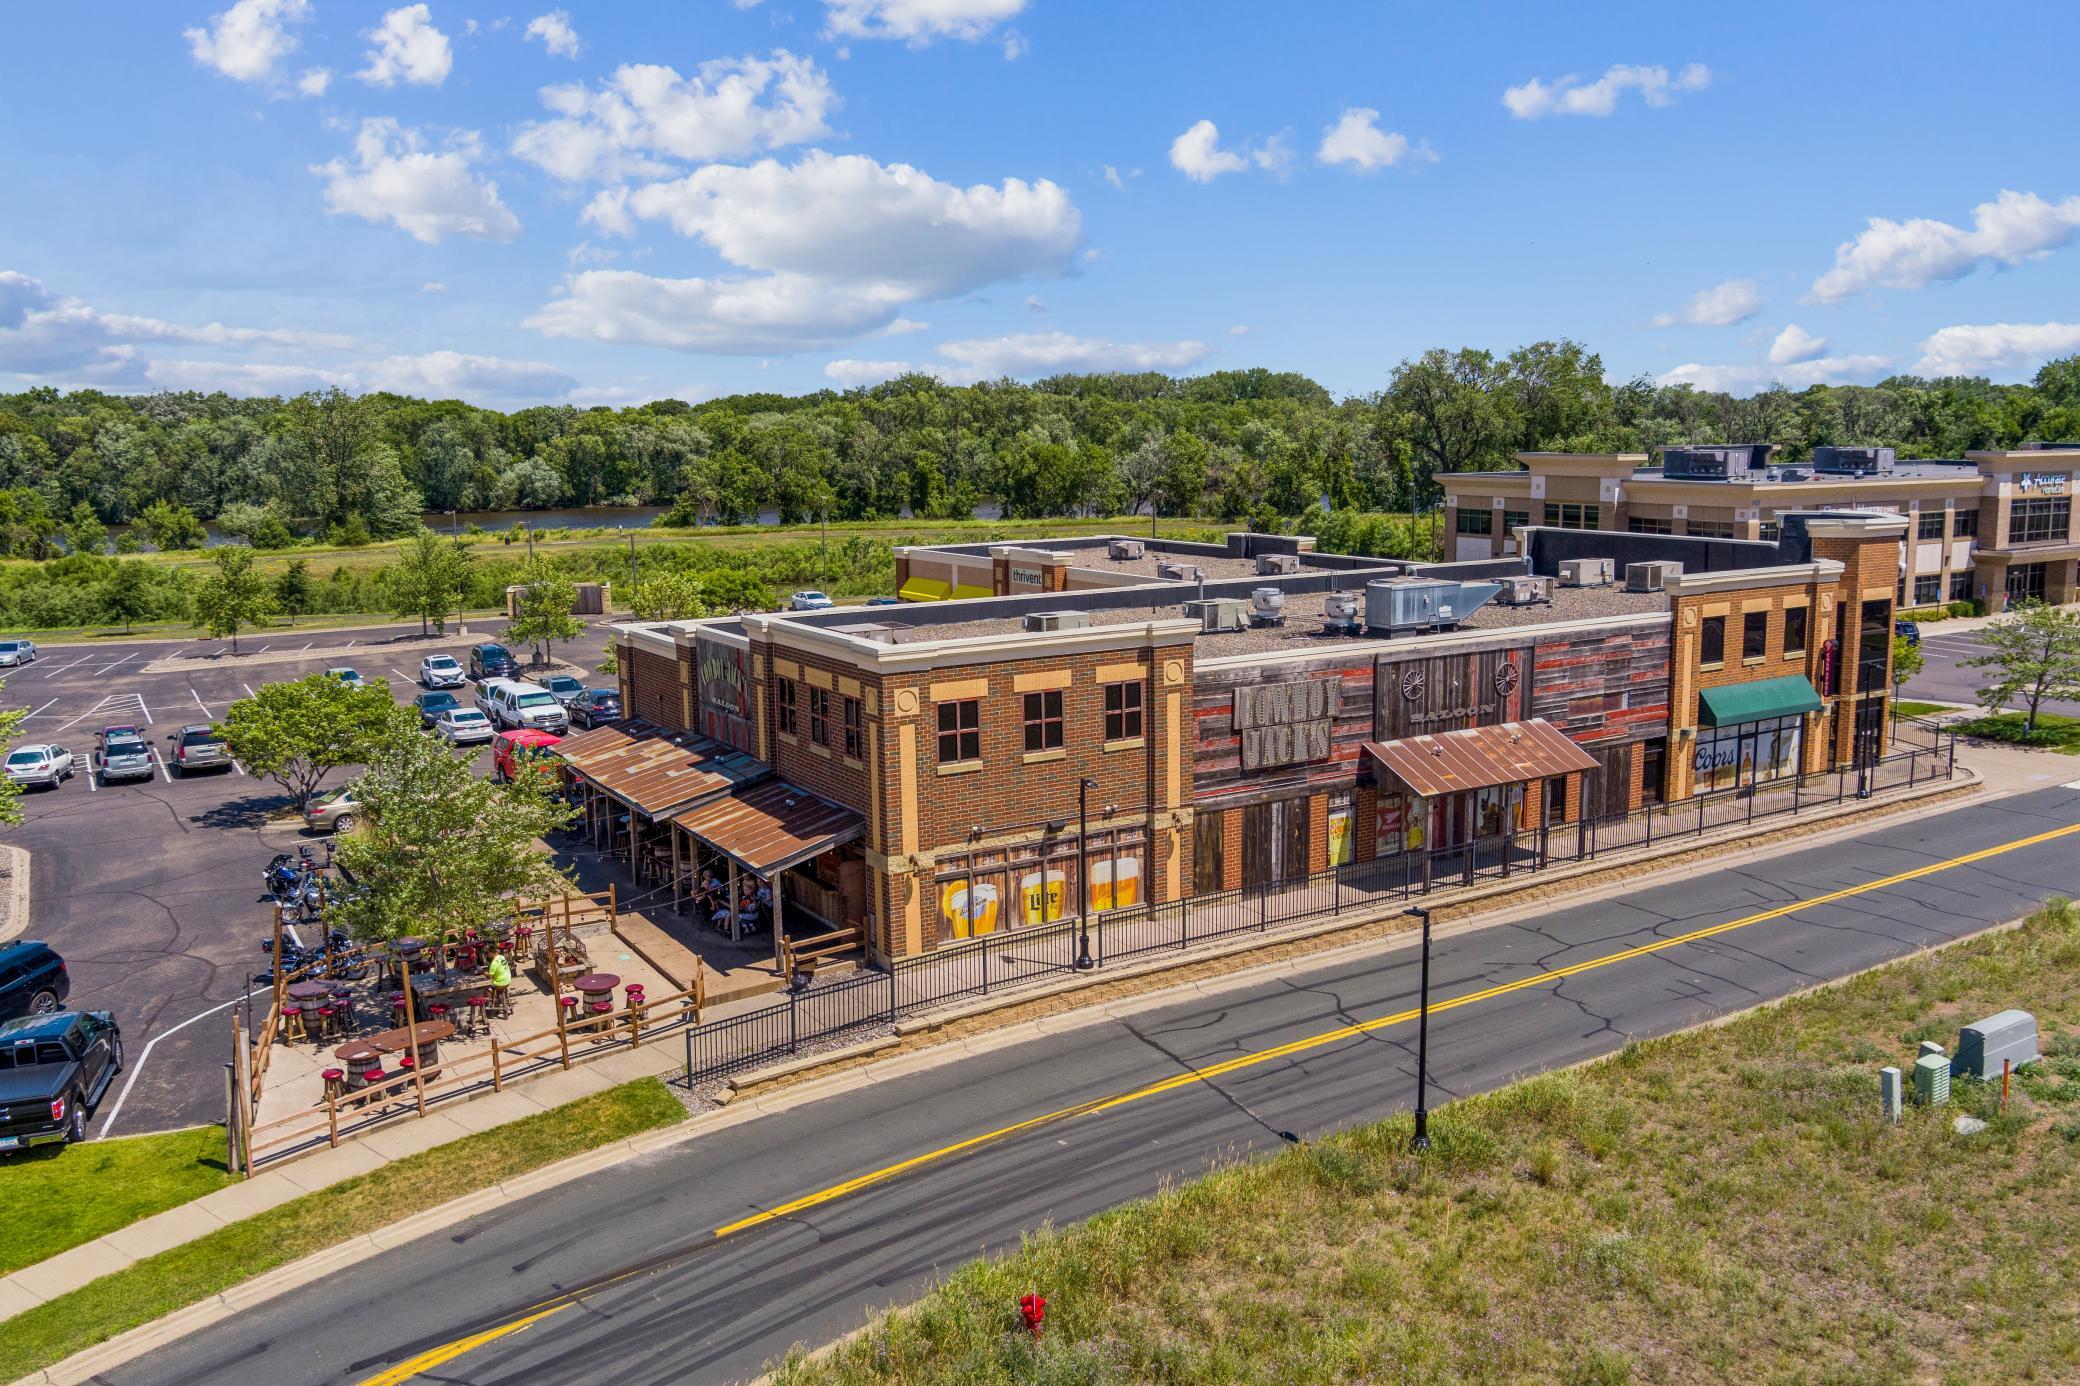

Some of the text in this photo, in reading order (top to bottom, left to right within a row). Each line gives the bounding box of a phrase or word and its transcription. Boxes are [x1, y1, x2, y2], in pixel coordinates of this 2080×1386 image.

[2033, 473, 2066, 488] Accurate
[1013, 569, 1042, 585] thrivent
[711, 696, 740, 713] SALOON
[1239, 678, 1340, 728] COWBOY
[1410, 703, 1496, 723] SALOON
[1695, 747, 1734, 771] Coors
